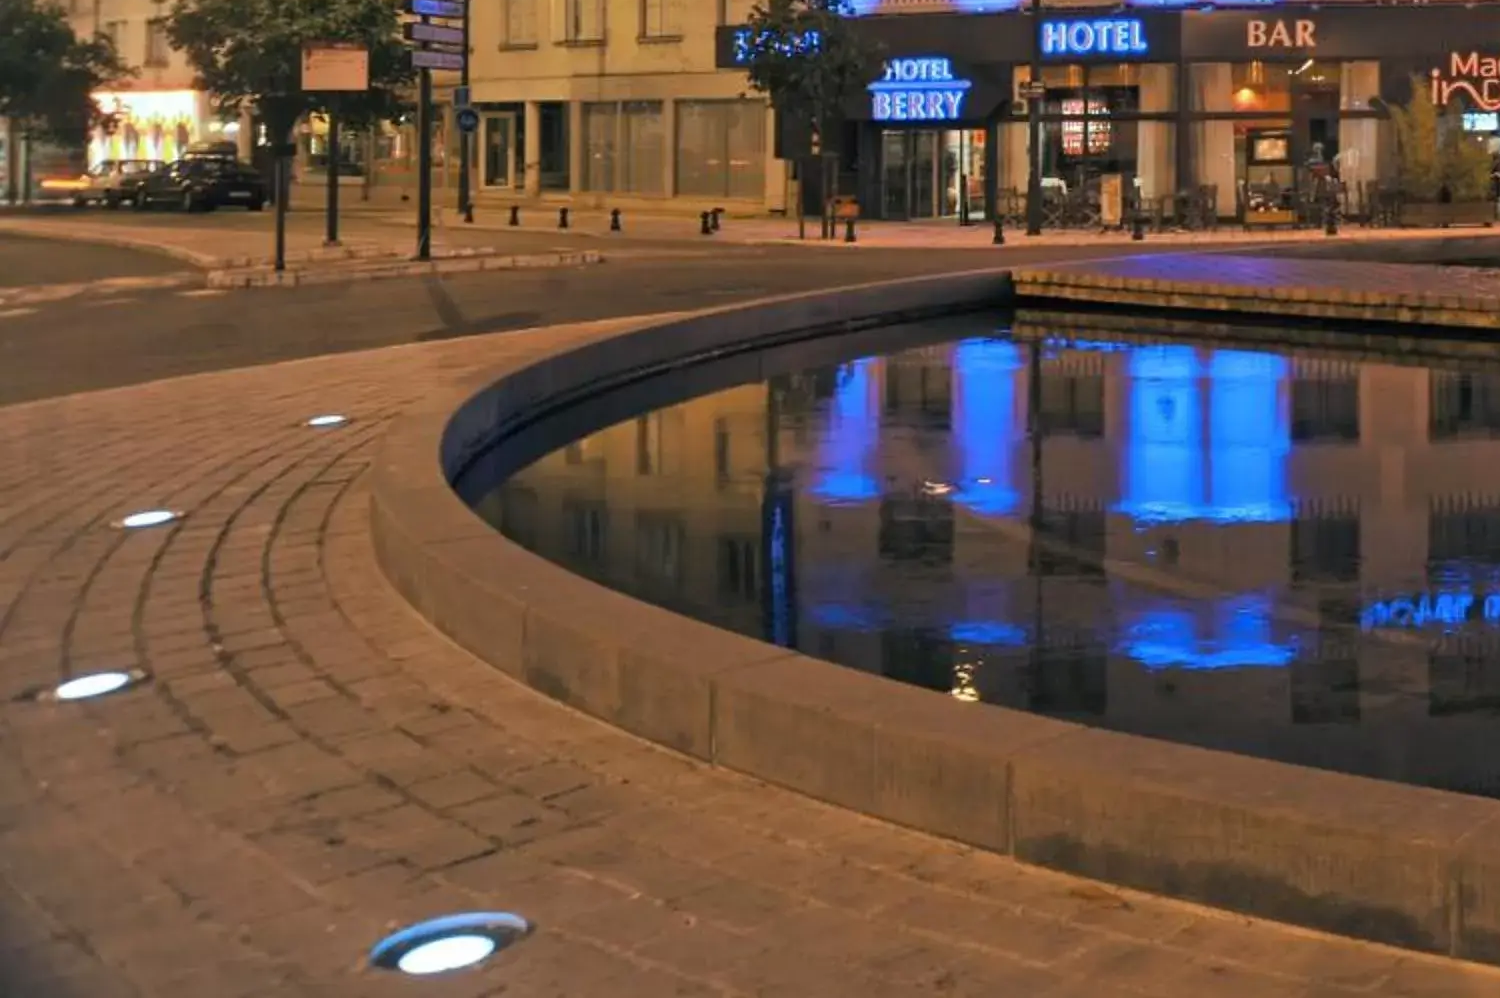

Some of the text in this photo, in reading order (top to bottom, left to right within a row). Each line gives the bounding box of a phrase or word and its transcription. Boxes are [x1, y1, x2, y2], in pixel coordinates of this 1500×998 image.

[1042, 21, 1147, 53] HOTEL
[1247, 20, 1316, 47] BAR
[883, 57, 953, 81] HOTEL
[873, 91, 963, 120] BERRY
